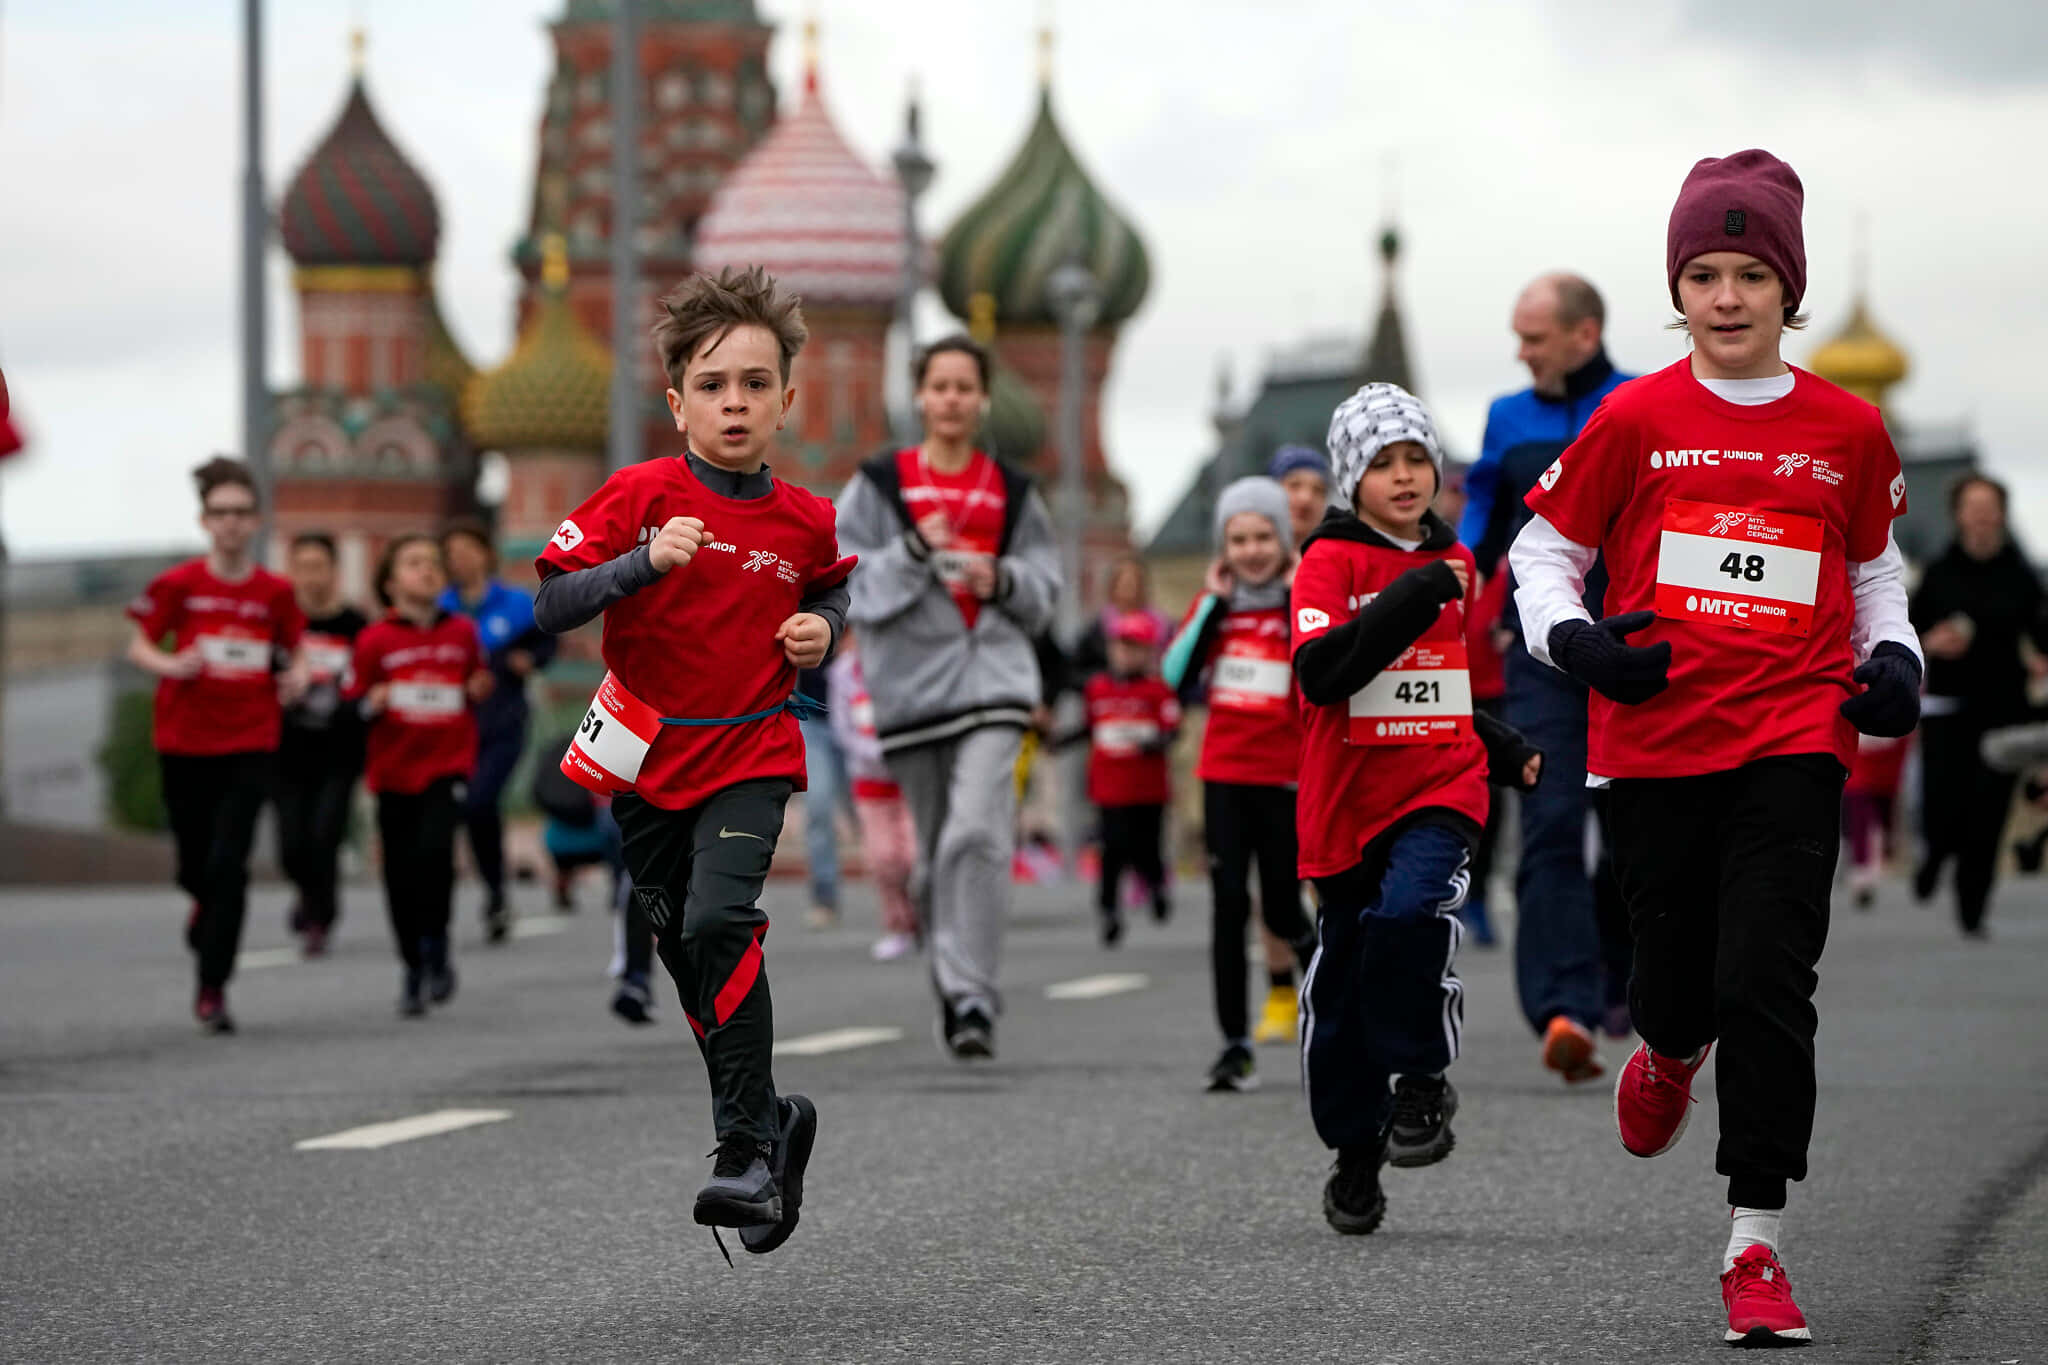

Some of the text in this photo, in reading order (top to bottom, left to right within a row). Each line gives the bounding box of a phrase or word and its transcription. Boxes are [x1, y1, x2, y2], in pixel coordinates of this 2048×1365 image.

[1722, 449, 1764, 461] JUNIOR
[704, 541, 737, 554] NIOR
[1719, 552, 1765, 582] 48
[1751, 604, 1787, 617] JUNIOR
[1395, 681, 1440, 703] 421
[575, 757, 604, 782] JUNIOR
